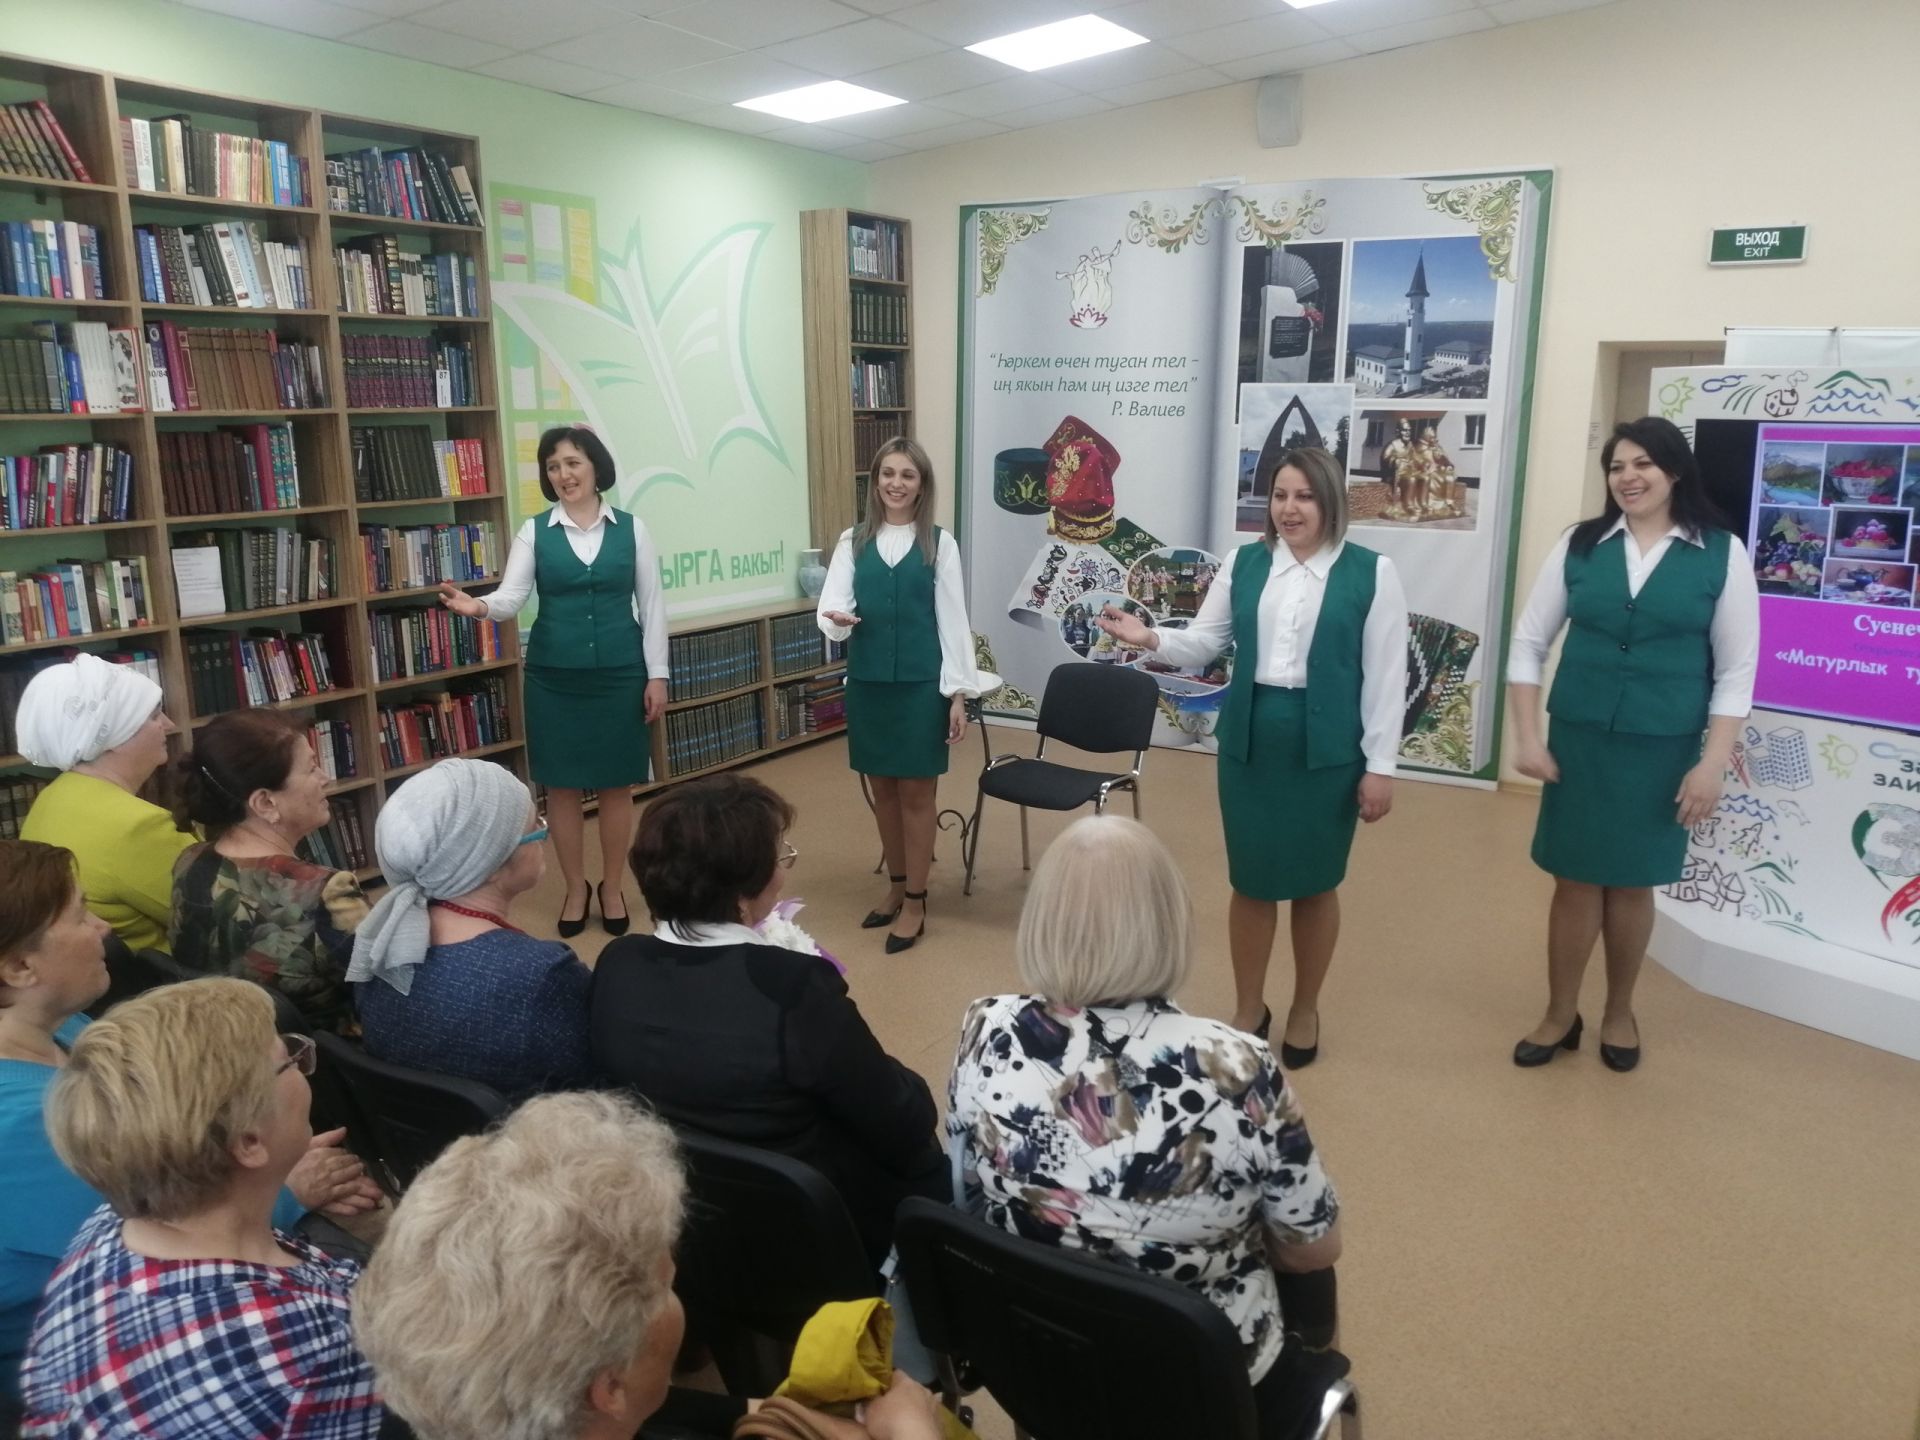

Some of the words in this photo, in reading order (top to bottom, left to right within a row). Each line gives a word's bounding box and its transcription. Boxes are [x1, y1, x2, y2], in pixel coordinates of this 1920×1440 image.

[1735, 230, 1780, 246] ВЫХОД
[1744, 246, 1771, 258] EXIT
[1054, 356, 1090, 369] өчен
[1094, 356, 1148, 373] туган
[1151, 356, 1187, 369] тел
[993, 380, 1012, 395] иң
[1015, 379, 1054, 392] якын
[1058, 376, 1087, 392] һәм
[1091, 381, 1111, 396] иң
[1115, 380, 1150, 393] изге
[1111, 400, 1123, 416] Р.
[1128, 400, 1186, 417] Вәлиев
[1775, 648, 1888, 675] «Матурлык
